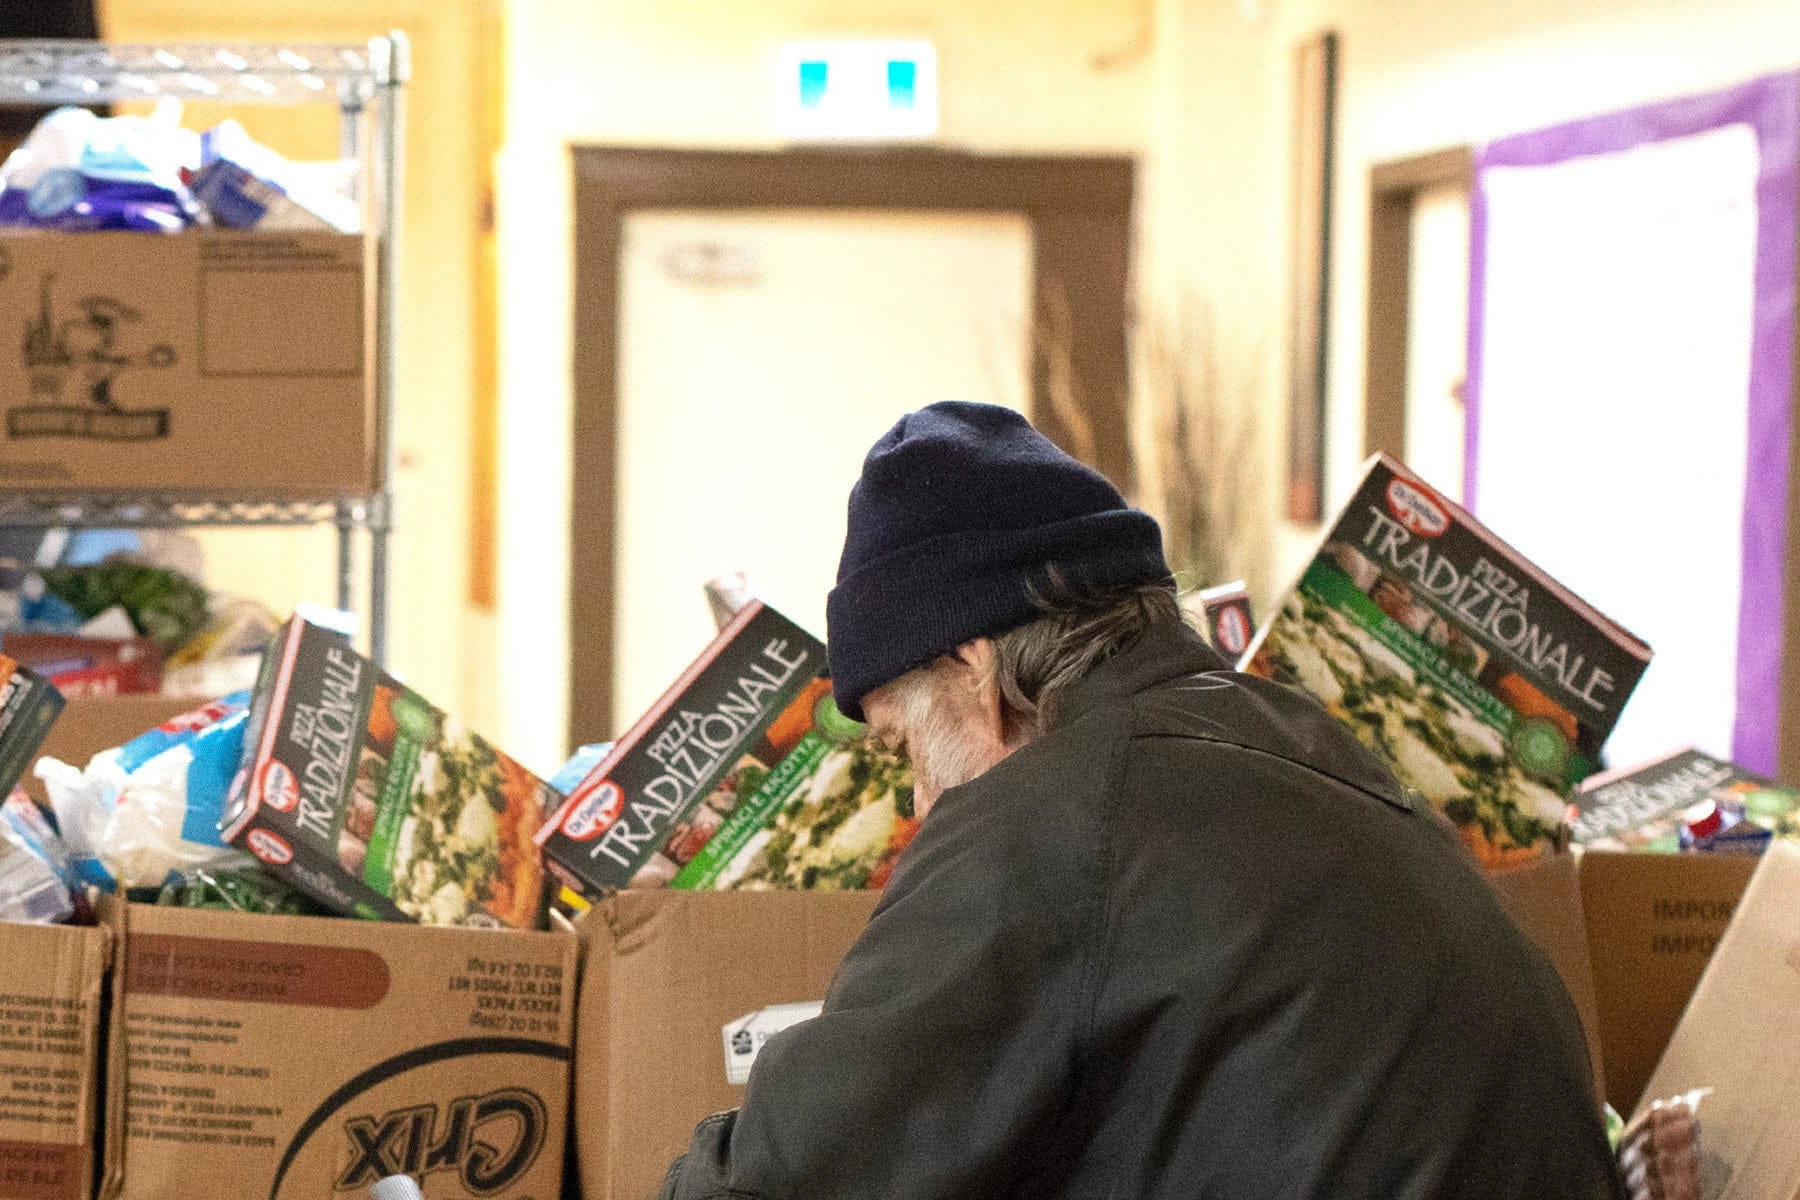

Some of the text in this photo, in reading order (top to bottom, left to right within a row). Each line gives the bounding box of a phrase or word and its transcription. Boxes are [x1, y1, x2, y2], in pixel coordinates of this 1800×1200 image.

[1365, 504, 1616, 712] TRADIZIONALE
[1472, 556, 1530, 613] PIZZA
[289, 701, 319, 750] PIZZA
[296, 648, 363, 839] TRADIZIONALE
[646, 709, 704, 764] PIZZA
[589, 638, 809, 868] TRADIZIONALE
[706, 803, 758, 856] SPINACI
[760, 735, 819, 801] RICOTTA
[447, 976, 470, 991] NET
[474, 977, 511, 993] POIDS
[513, 962, 532, 977] OZ
[540, 982, 562, 996] NET
[477, 996, 560, 1013] PACKS/ PACKS
[508, 1015, 527, 1031] OZ
[332, 1086, 549, 1196] Crix
